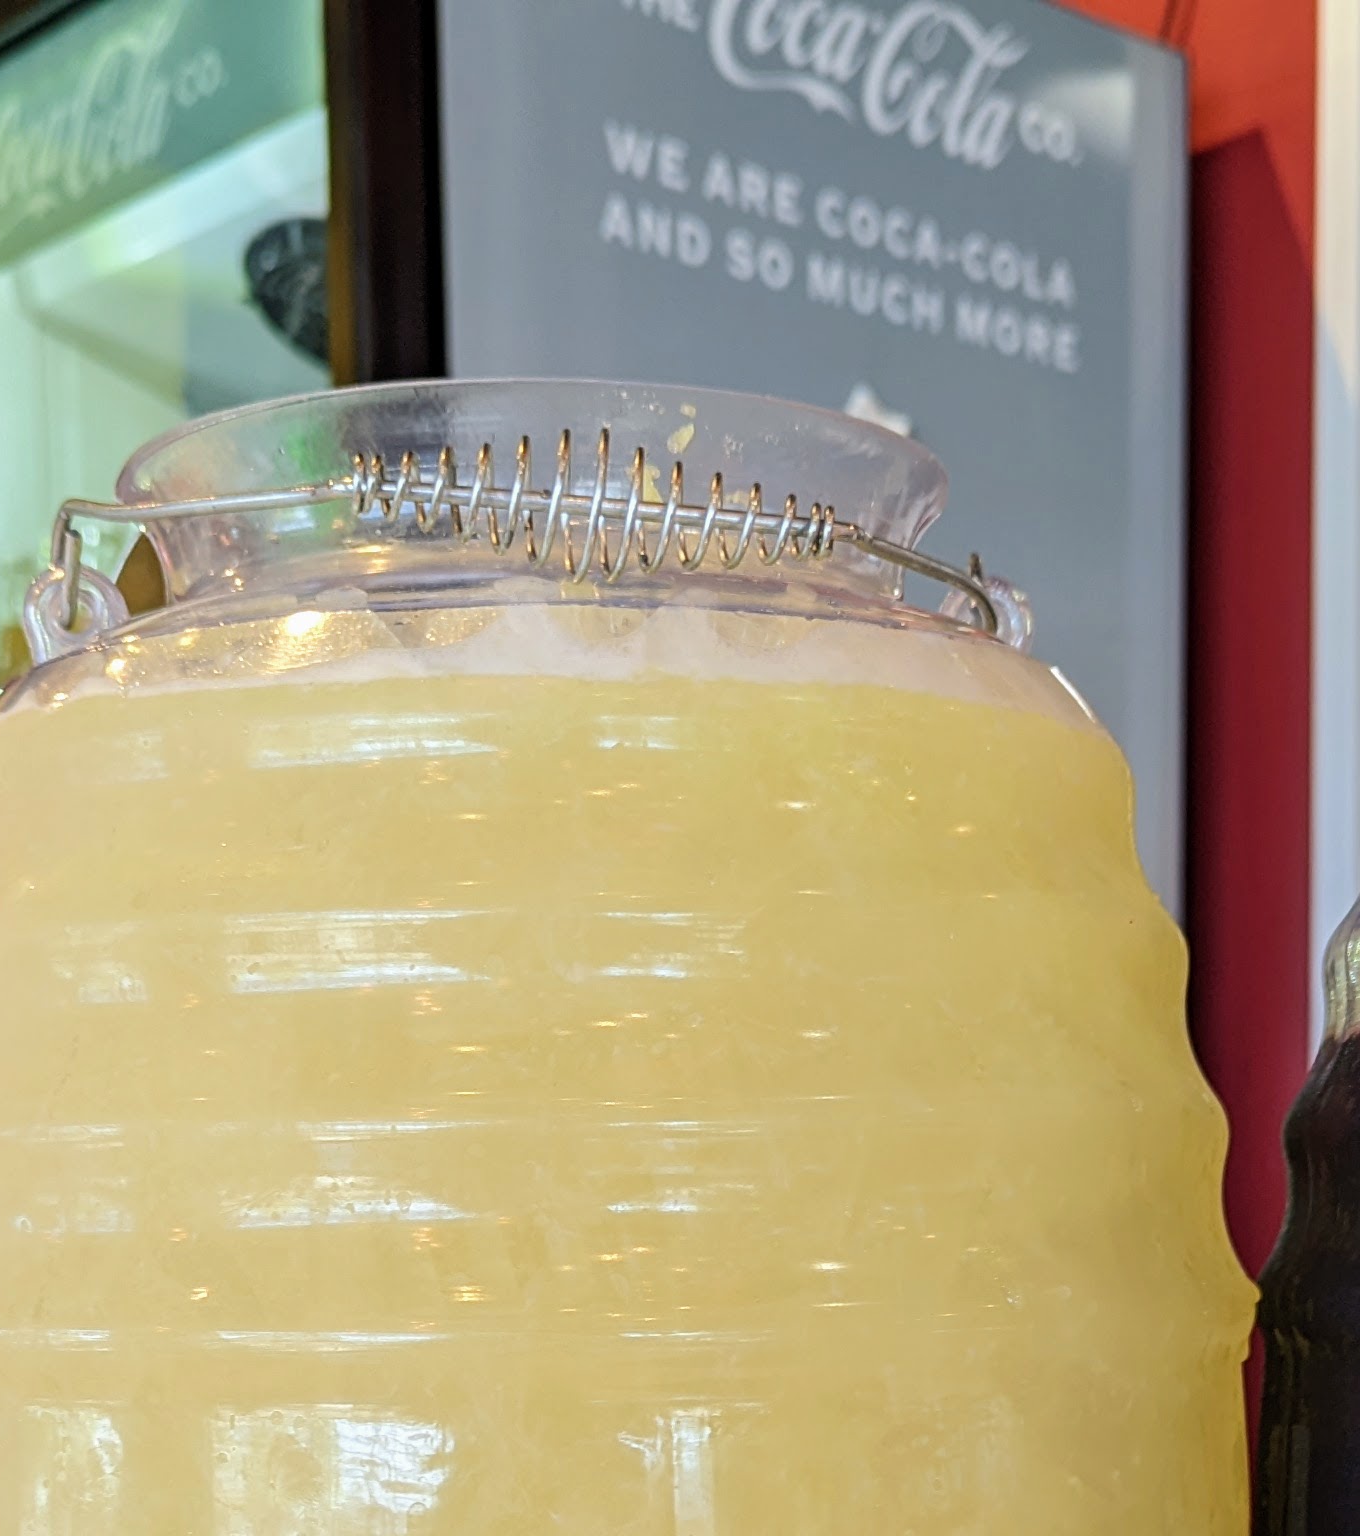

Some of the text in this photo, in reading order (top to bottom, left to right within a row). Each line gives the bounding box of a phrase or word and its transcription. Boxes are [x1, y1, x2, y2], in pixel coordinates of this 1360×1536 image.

[600, 193, 1080, 372] AND SO MUCH MORE
[604, 120, 1076, 307] WE ARE COCA-COLA
